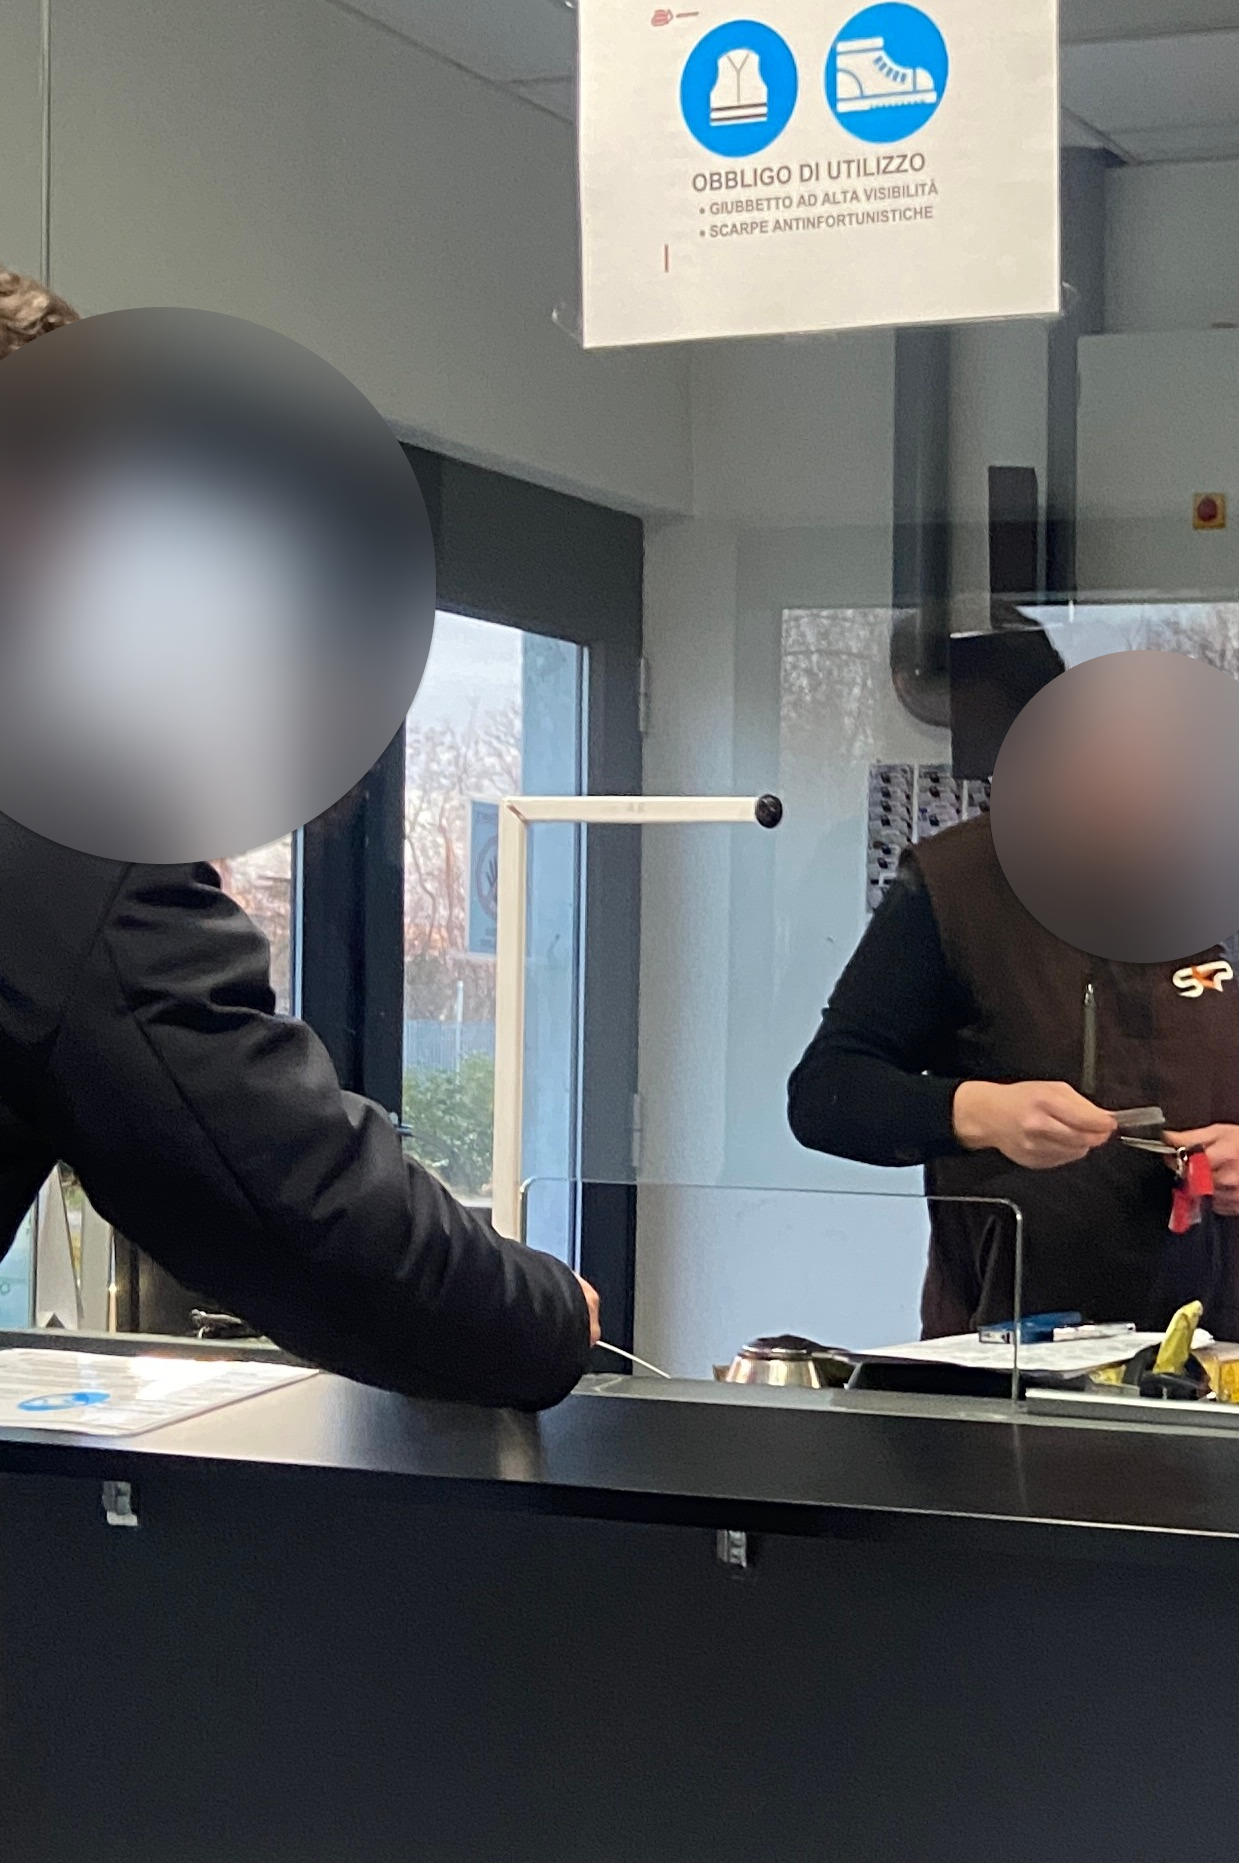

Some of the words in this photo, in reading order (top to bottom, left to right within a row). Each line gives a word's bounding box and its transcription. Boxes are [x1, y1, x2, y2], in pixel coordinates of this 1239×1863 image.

[693, 166, 792, 191] OBBLIGO
[800, 162, 819, 182] DI
[827, 153, 925, 180] UTILIZZO
[710, 196, 793, 215] GIUBBETTO
[797, 194, 818, 208] AD
[821, 190, 860, 206] ALTA
[864, 179, 938, 201] VISIBILITÀ
[710, 220, 769, 238] SCARPE
[773, 206, 934, 232] ANTINFORTUNISTICHE
